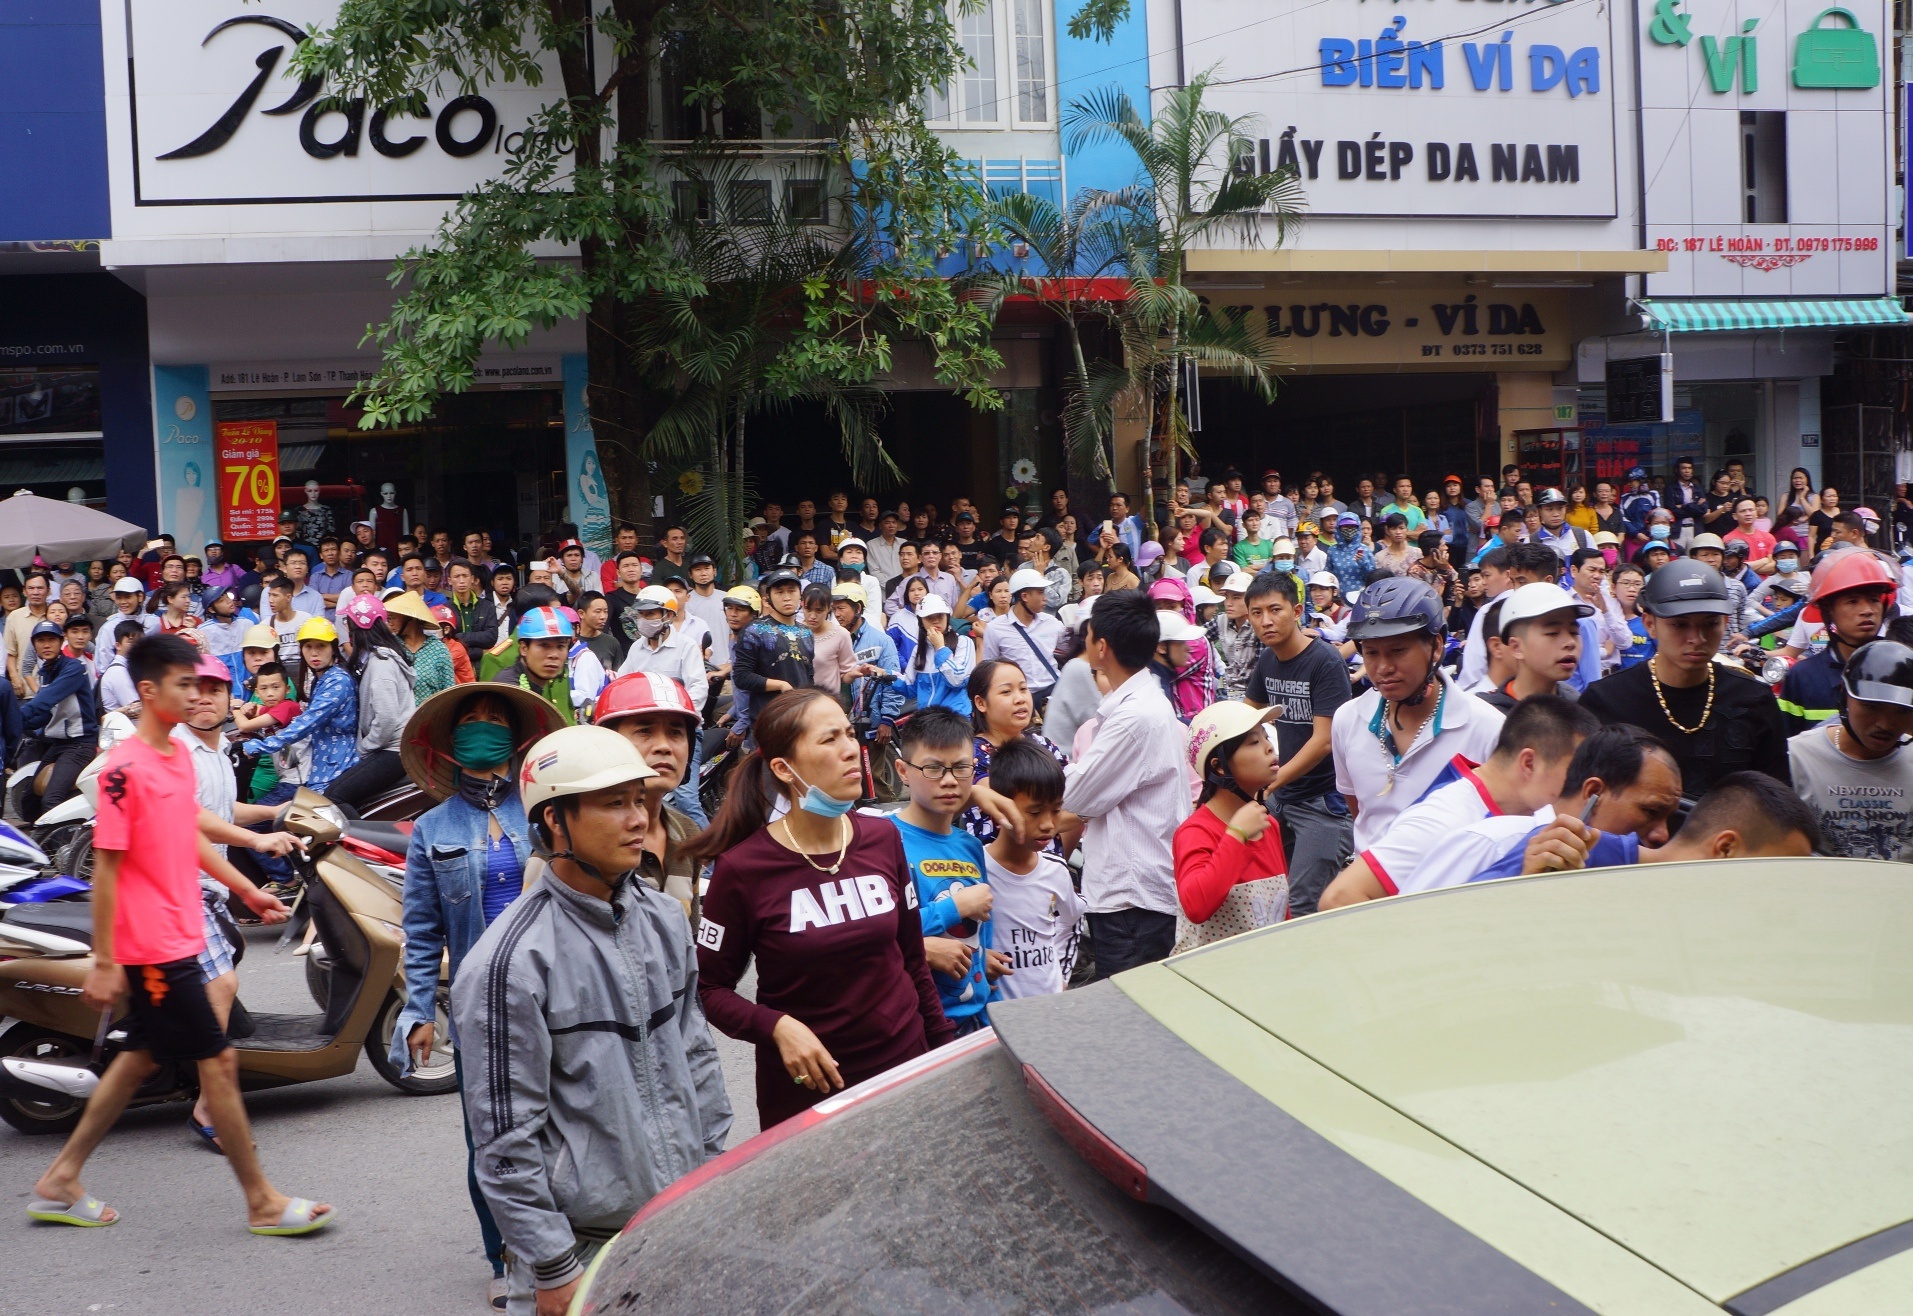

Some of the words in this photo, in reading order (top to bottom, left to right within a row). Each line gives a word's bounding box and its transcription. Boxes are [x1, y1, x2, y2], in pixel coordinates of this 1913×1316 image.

[1319, 16, 1445, 89] BIỂN
[1462, 30, 1514, 91] VÍ
[1529, 44, 1600, 98] DA
[1699, 17, 1761, 94] VÍ
[155, 14, 497, 159] Paco
[1337, 131, 1414, 180] DÉP
[1427, 142, 1480, 182] DA
[1491, 143, 1580, 183] NAM
[1797, 237, 1829, 251] 0979
[1831, 237, 1852, 251] 175
[1431, 294, 1480, 336] VÍ
[1487, 303, 1546, 335] DA
[1453, 343, 1487, 355] 0373
[1490, 343, 1513, 355] 751
[1517, 343, 1543, 355] 628
[1265, 676, 1311, 695] CONVERSE
[1827, 784, 1904, 798] NEWTOWN
[789, 874, 896, 933] AHB
[1011, 928, 1038, 946] Fly
